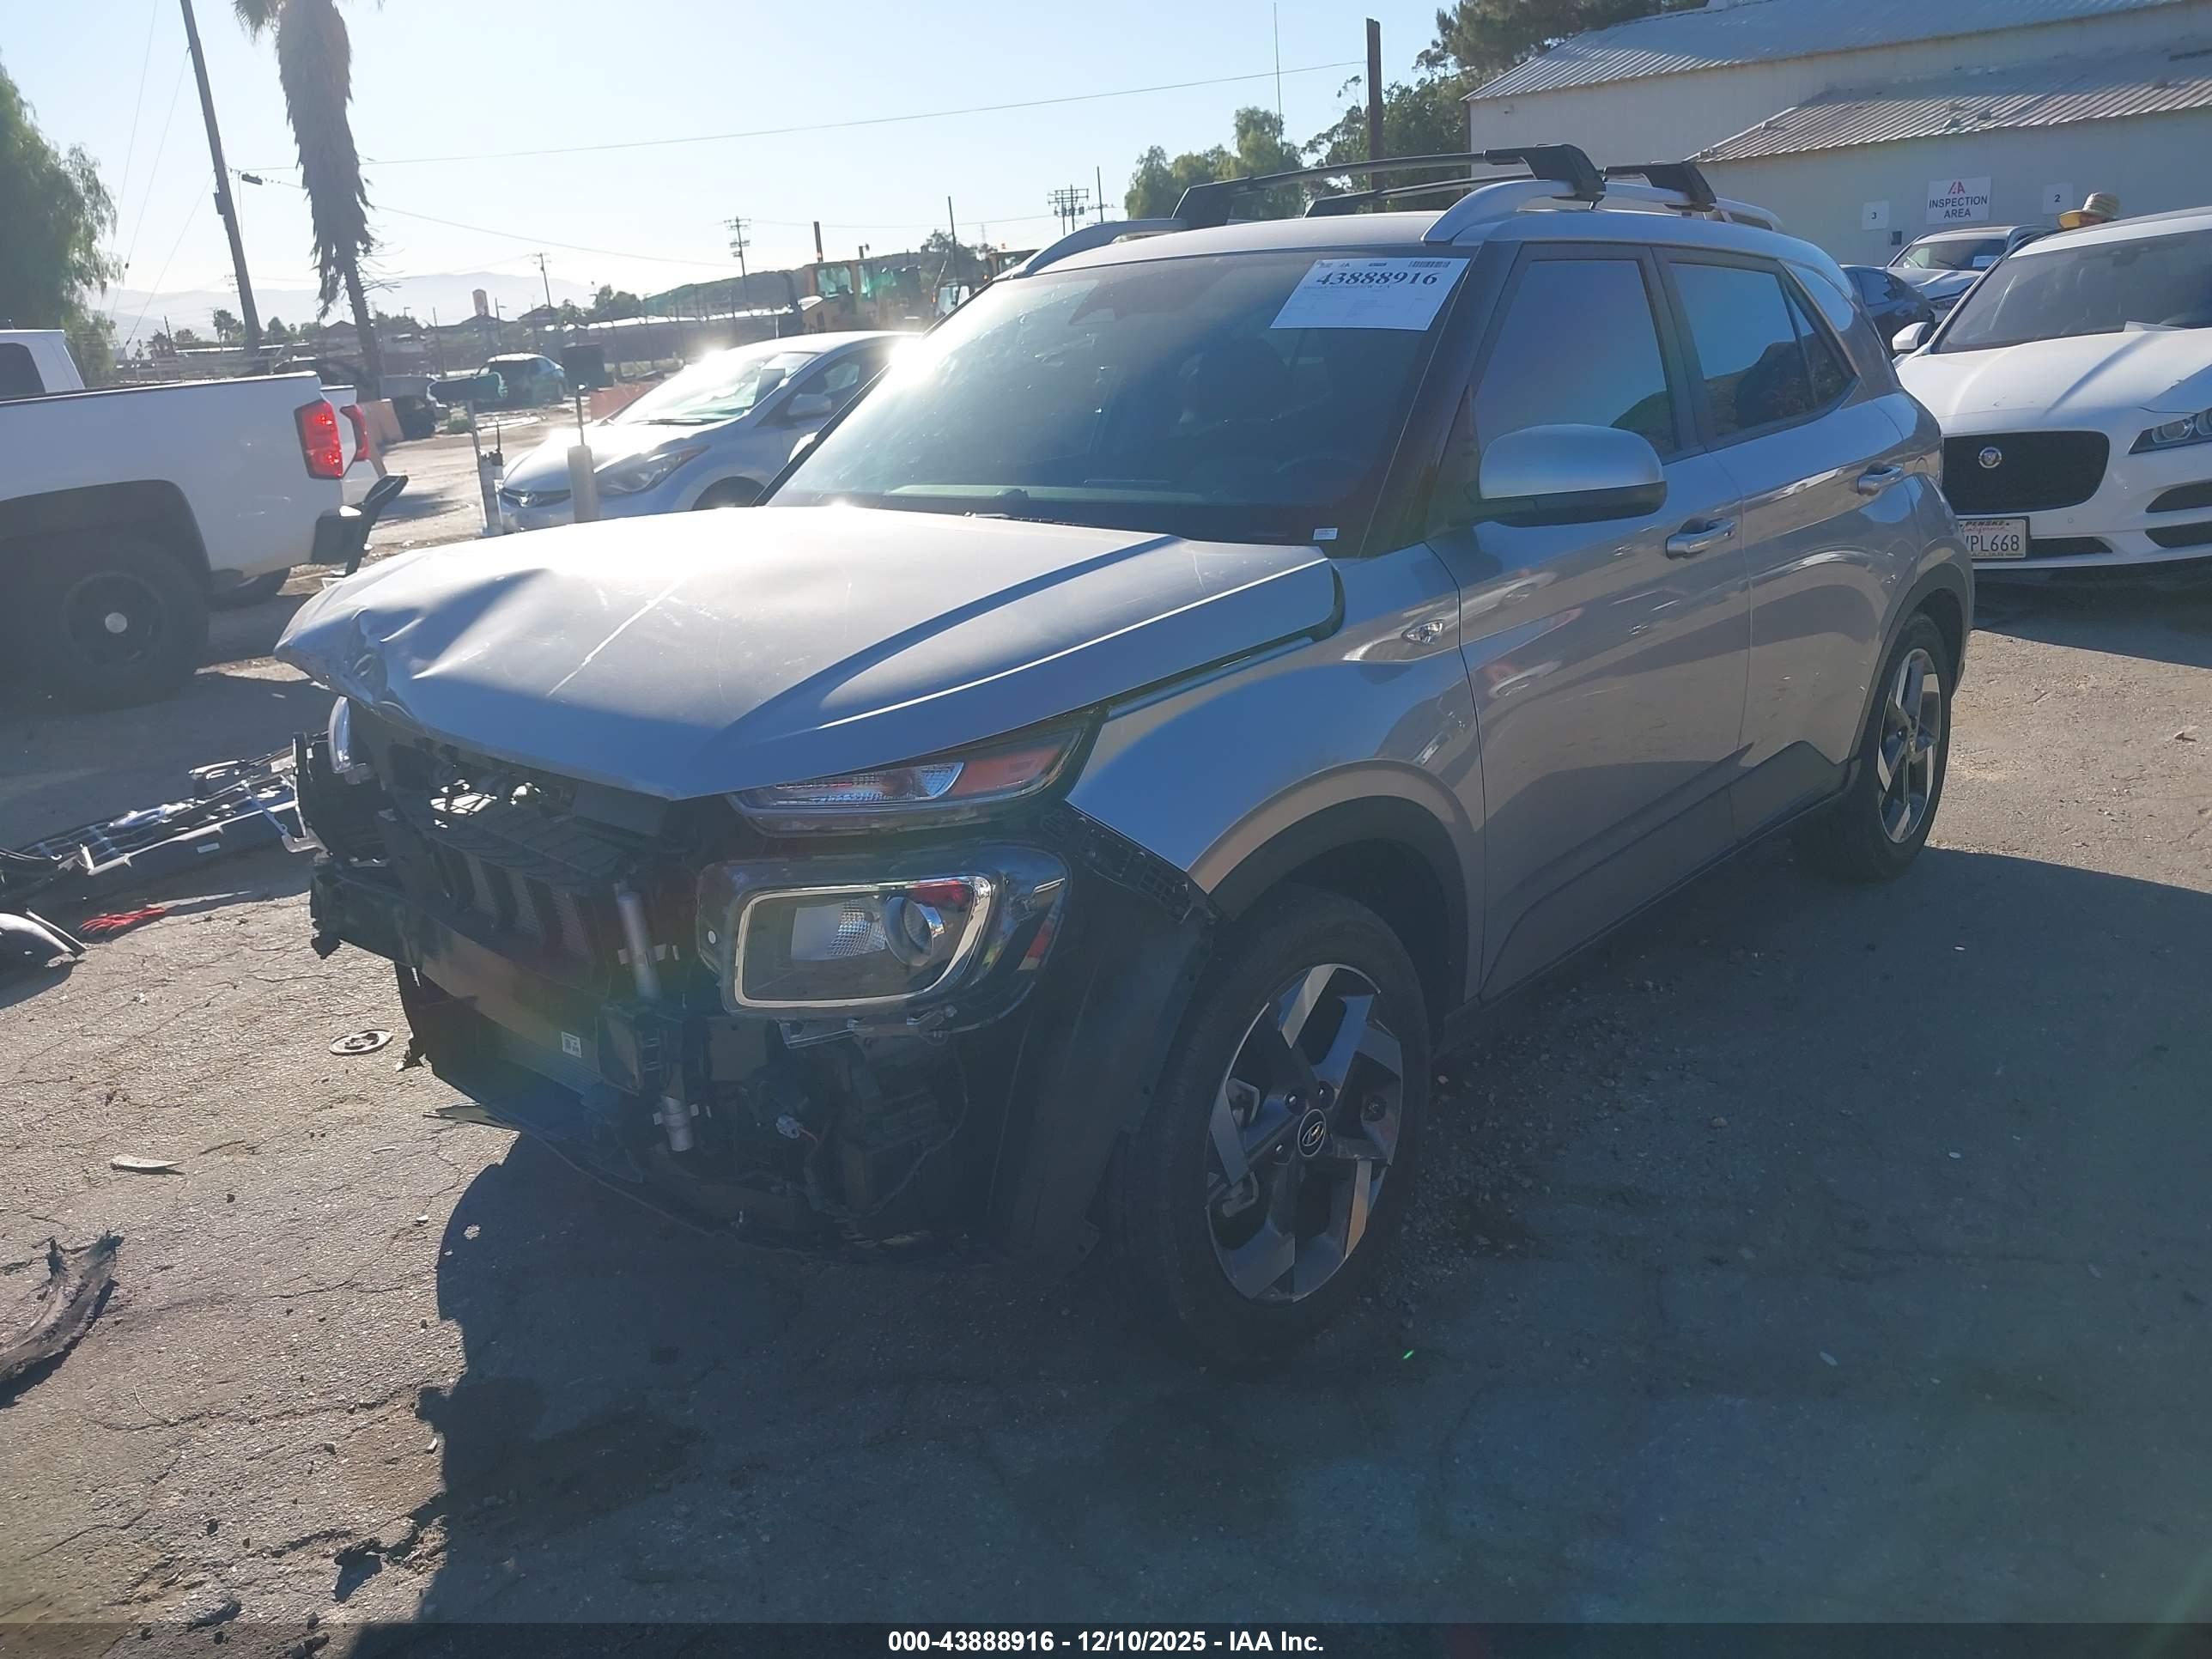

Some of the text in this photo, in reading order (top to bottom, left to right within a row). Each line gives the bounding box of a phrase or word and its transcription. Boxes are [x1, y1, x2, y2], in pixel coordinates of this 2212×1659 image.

[1929, 195, 1988, 209] INSPECTION
[2054, 194, 2061, 203] 2
[1943, 209, 1972, 219] AREA
[1316, 271, 1443, 285] 43888916
